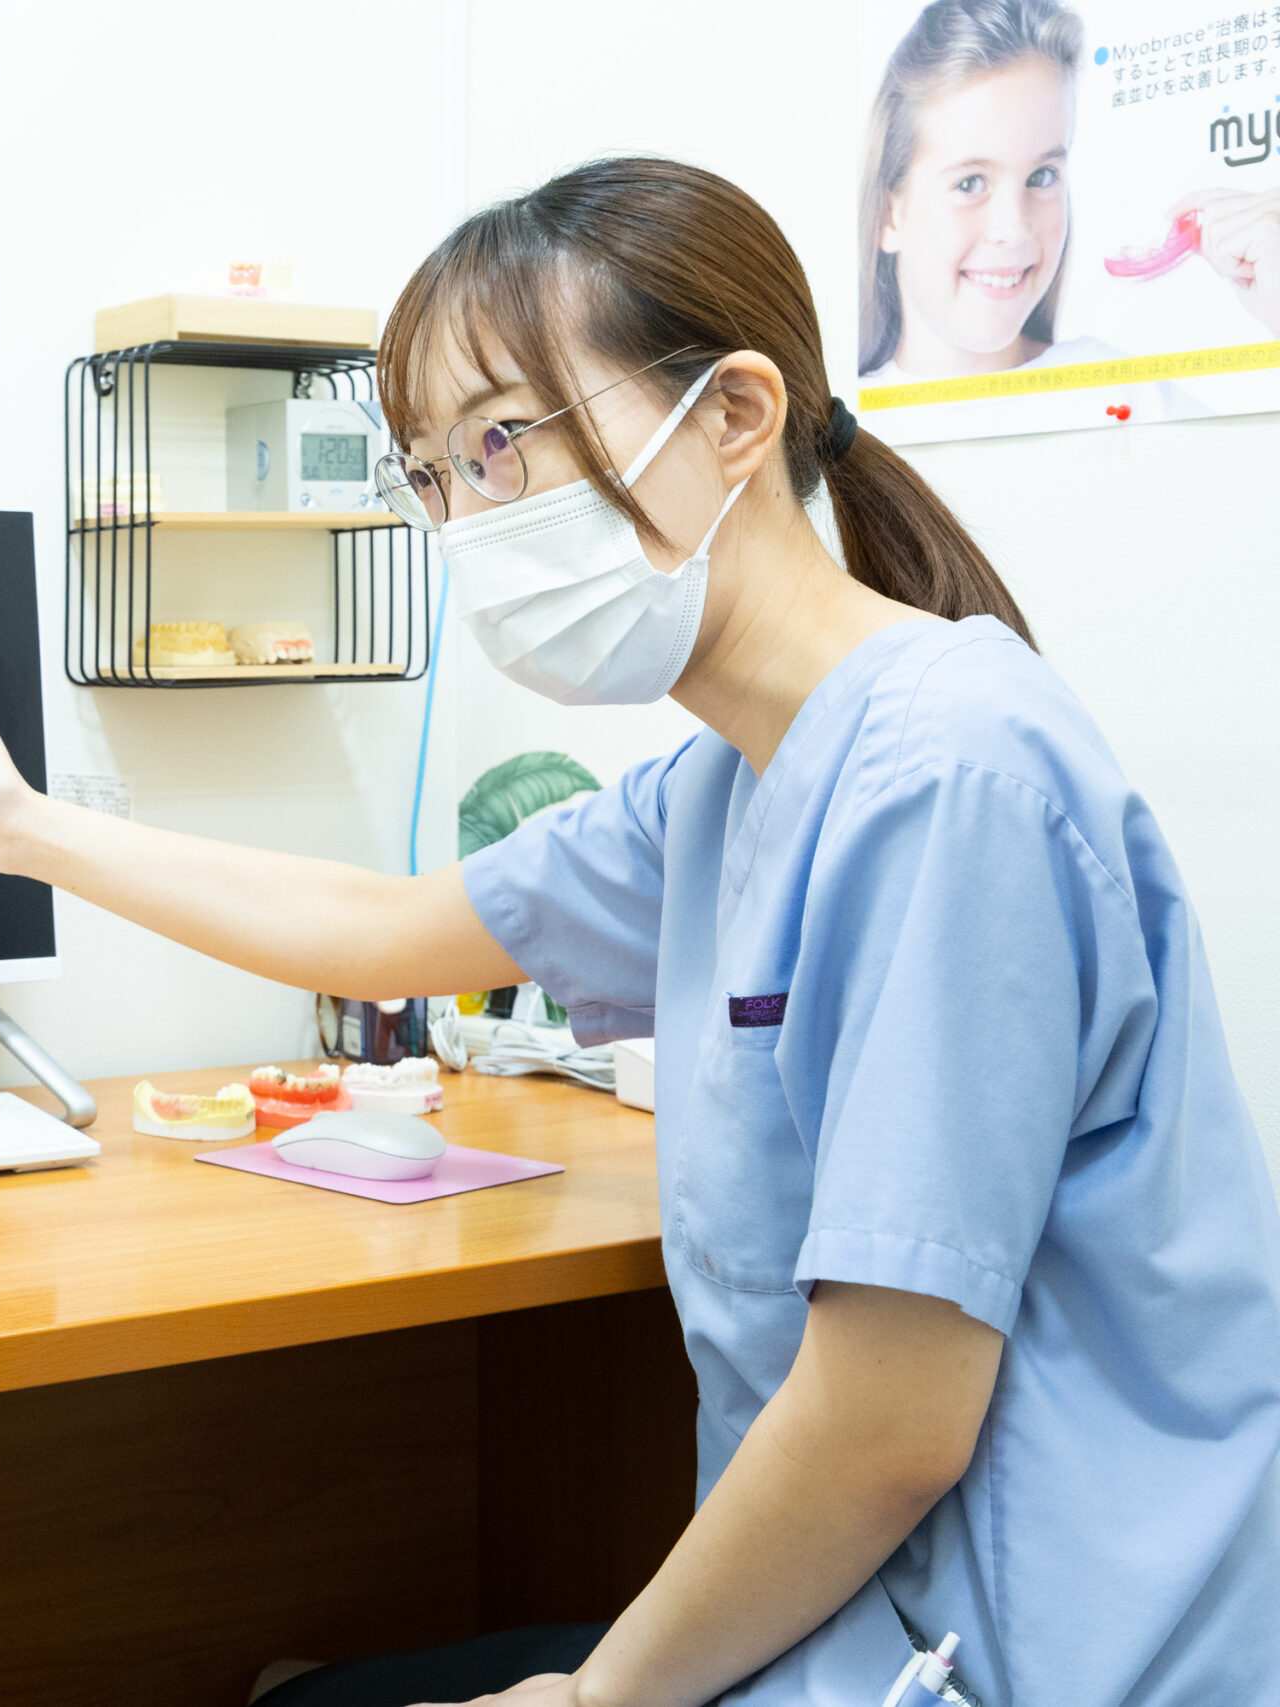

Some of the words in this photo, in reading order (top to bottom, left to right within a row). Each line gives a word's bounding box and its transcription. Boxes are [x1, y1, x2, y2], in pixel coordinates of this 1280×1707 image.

[1112, 58, 1277, 108] 歯並びを改善します。
[1210, 95, 1280, 168] my
[745, 997, 781, 1011] FOLK
